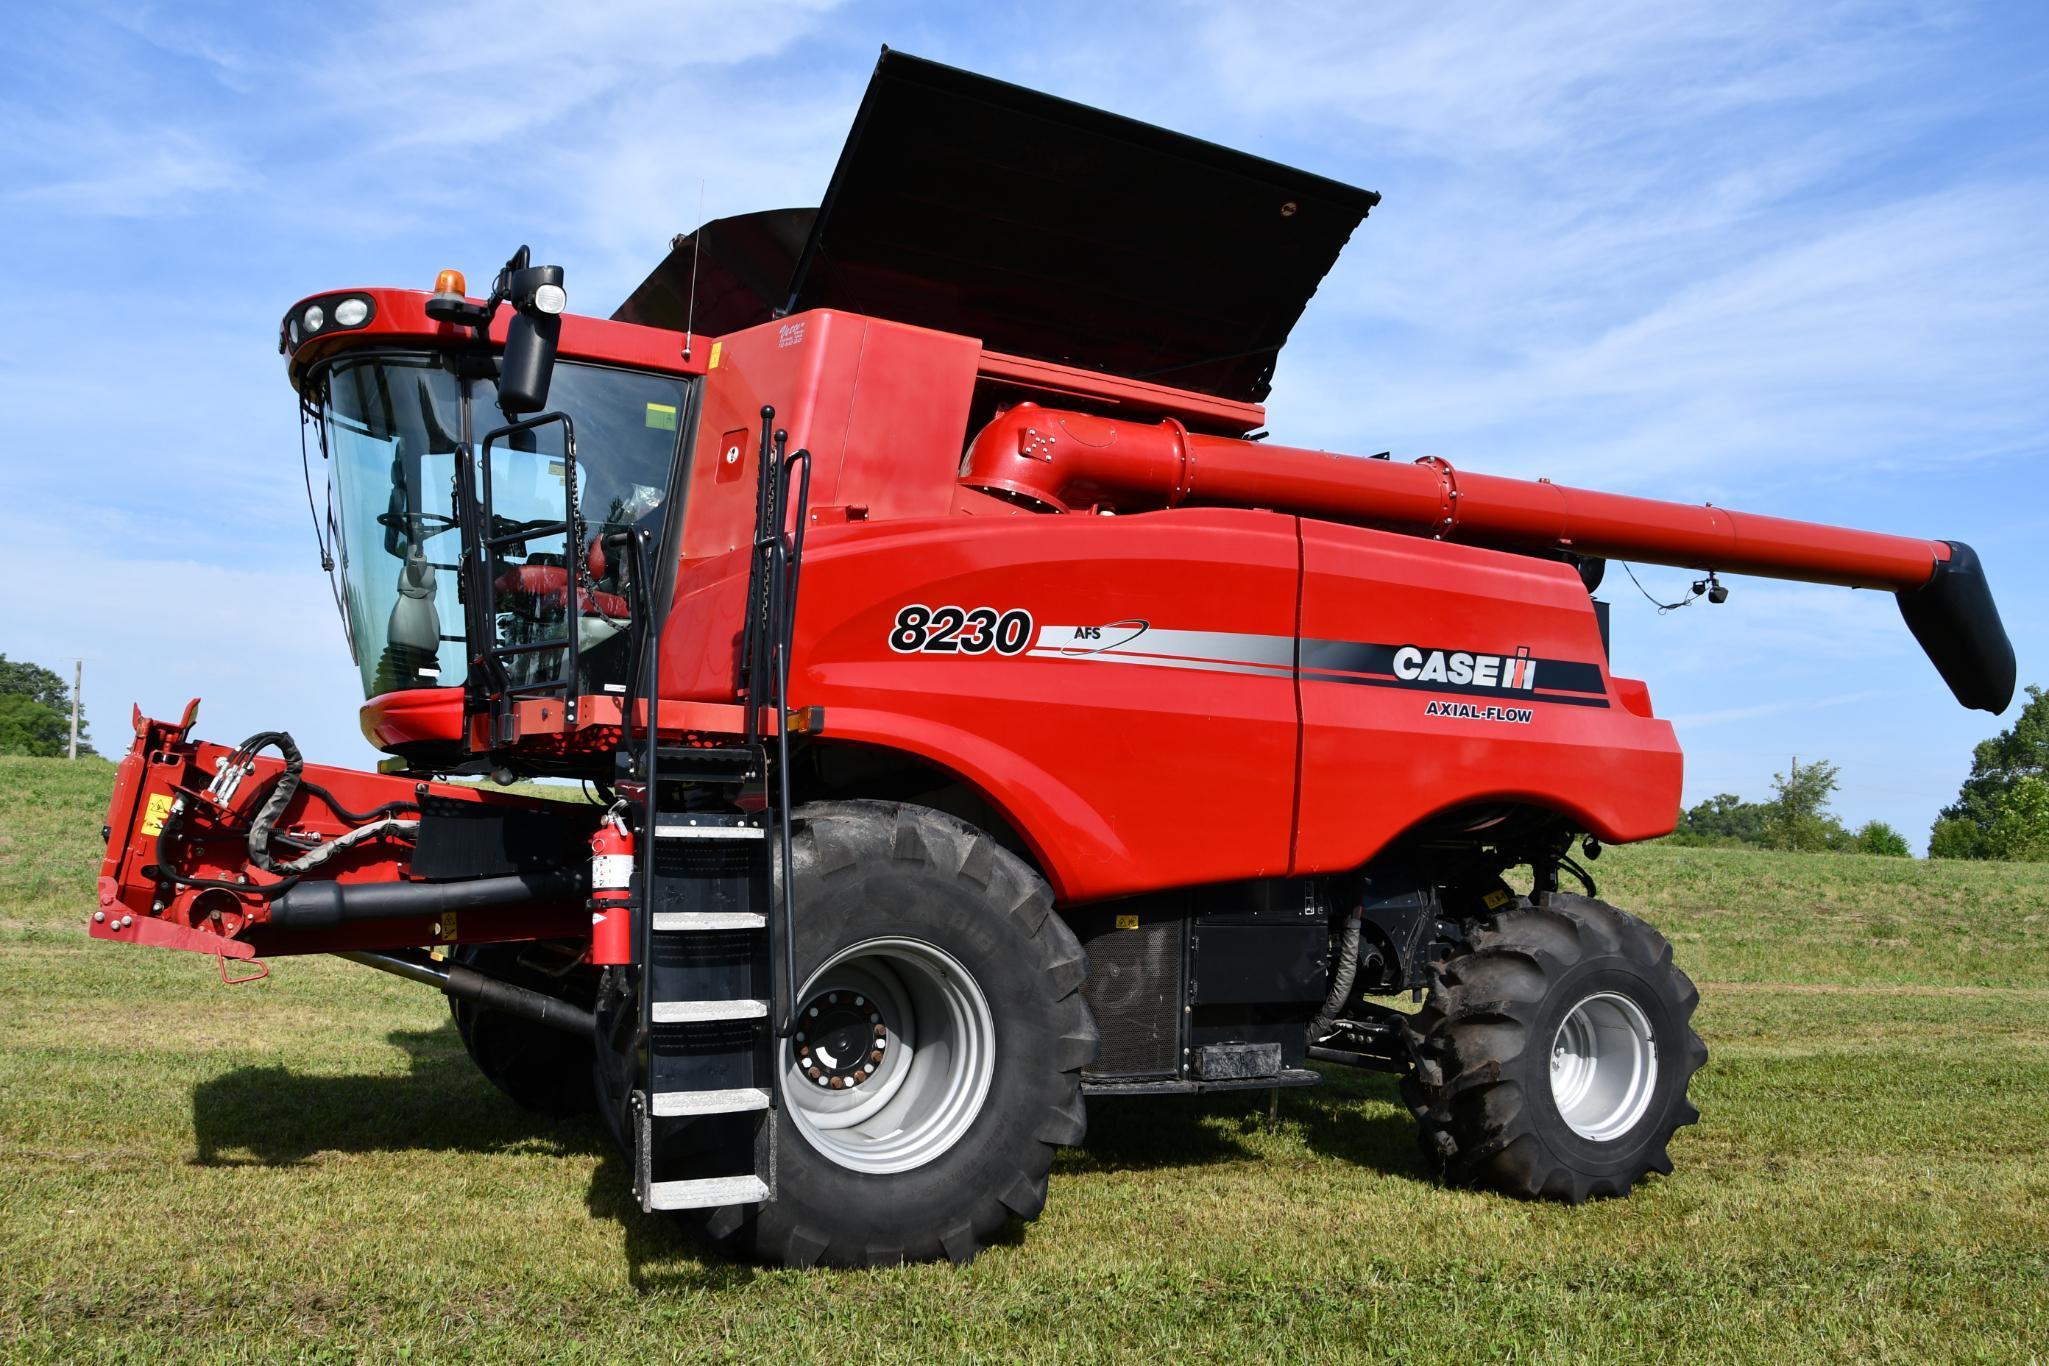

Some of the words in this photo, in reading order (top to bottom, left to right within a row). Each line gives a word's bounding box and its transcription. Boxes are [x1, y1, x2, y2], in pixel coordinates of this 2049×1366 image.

[889, 604, 1034, 656] 8230
[1073, 626, 1101, 640] AFS
[1392, 646, 1501, 687] CASE
[1425, 701, 1533, 724] AXIAL-FLOW
